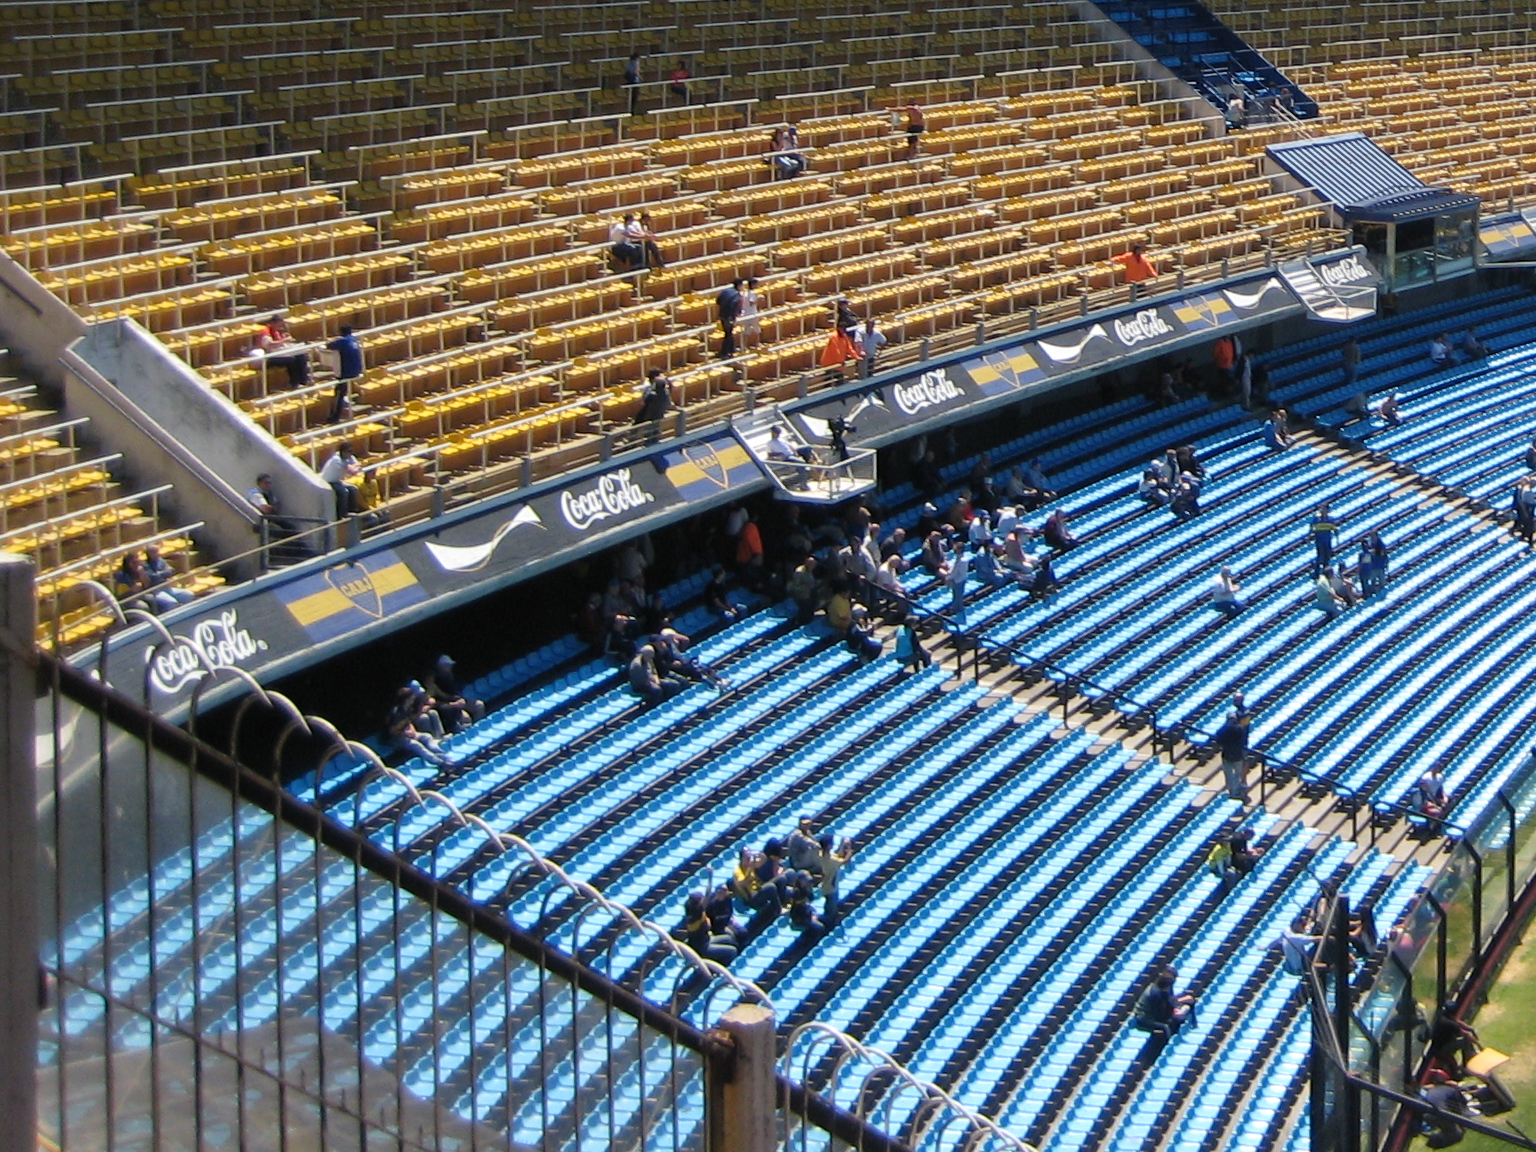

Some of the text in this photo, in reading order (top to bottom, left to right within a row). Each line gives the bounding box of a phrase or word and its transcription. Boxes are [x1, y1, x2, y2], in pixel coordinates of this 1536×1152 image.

[1114, 308, 1174, 346] Coca-Cola
[893, 367, 965, 416] Coca-Cola
[561, 467, 655, 530] Coca-Cola
